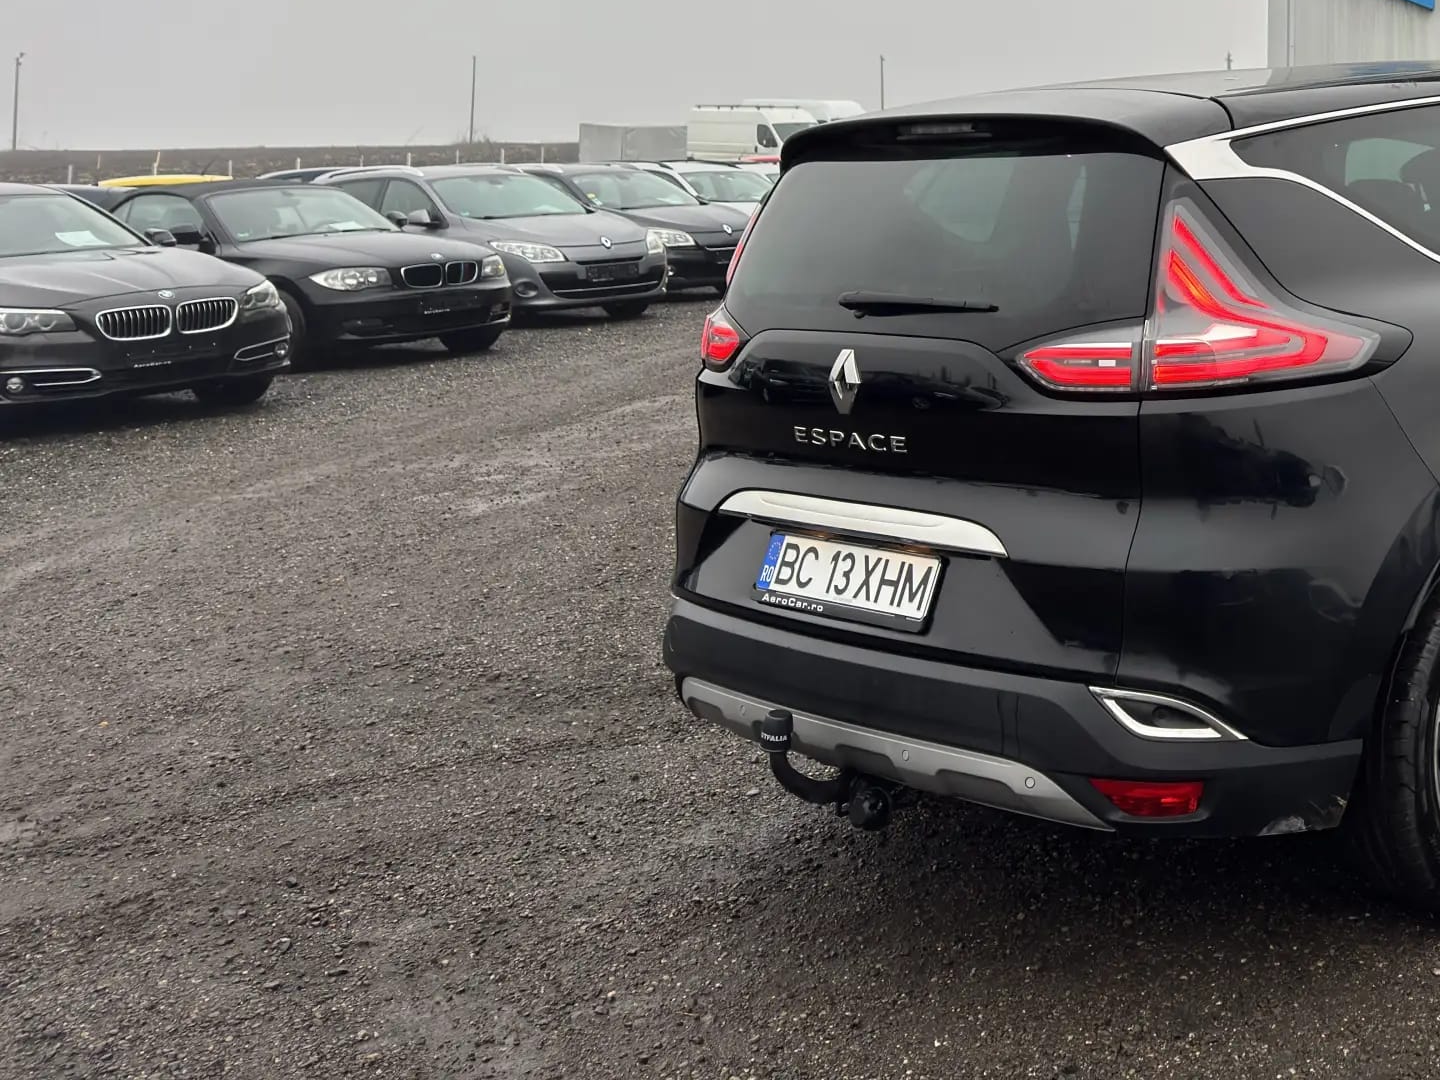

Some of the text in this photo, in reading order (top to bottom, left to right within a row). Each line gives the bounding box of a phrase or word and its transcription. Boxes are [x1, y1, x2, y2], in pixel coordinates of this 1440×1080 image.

[793, 425, 908, 453] ESPACE
[759, 564, 775, 583] RO
[774, 542, 819, 589] BC
[761, 593, 824, 612] AeroCar.ro
